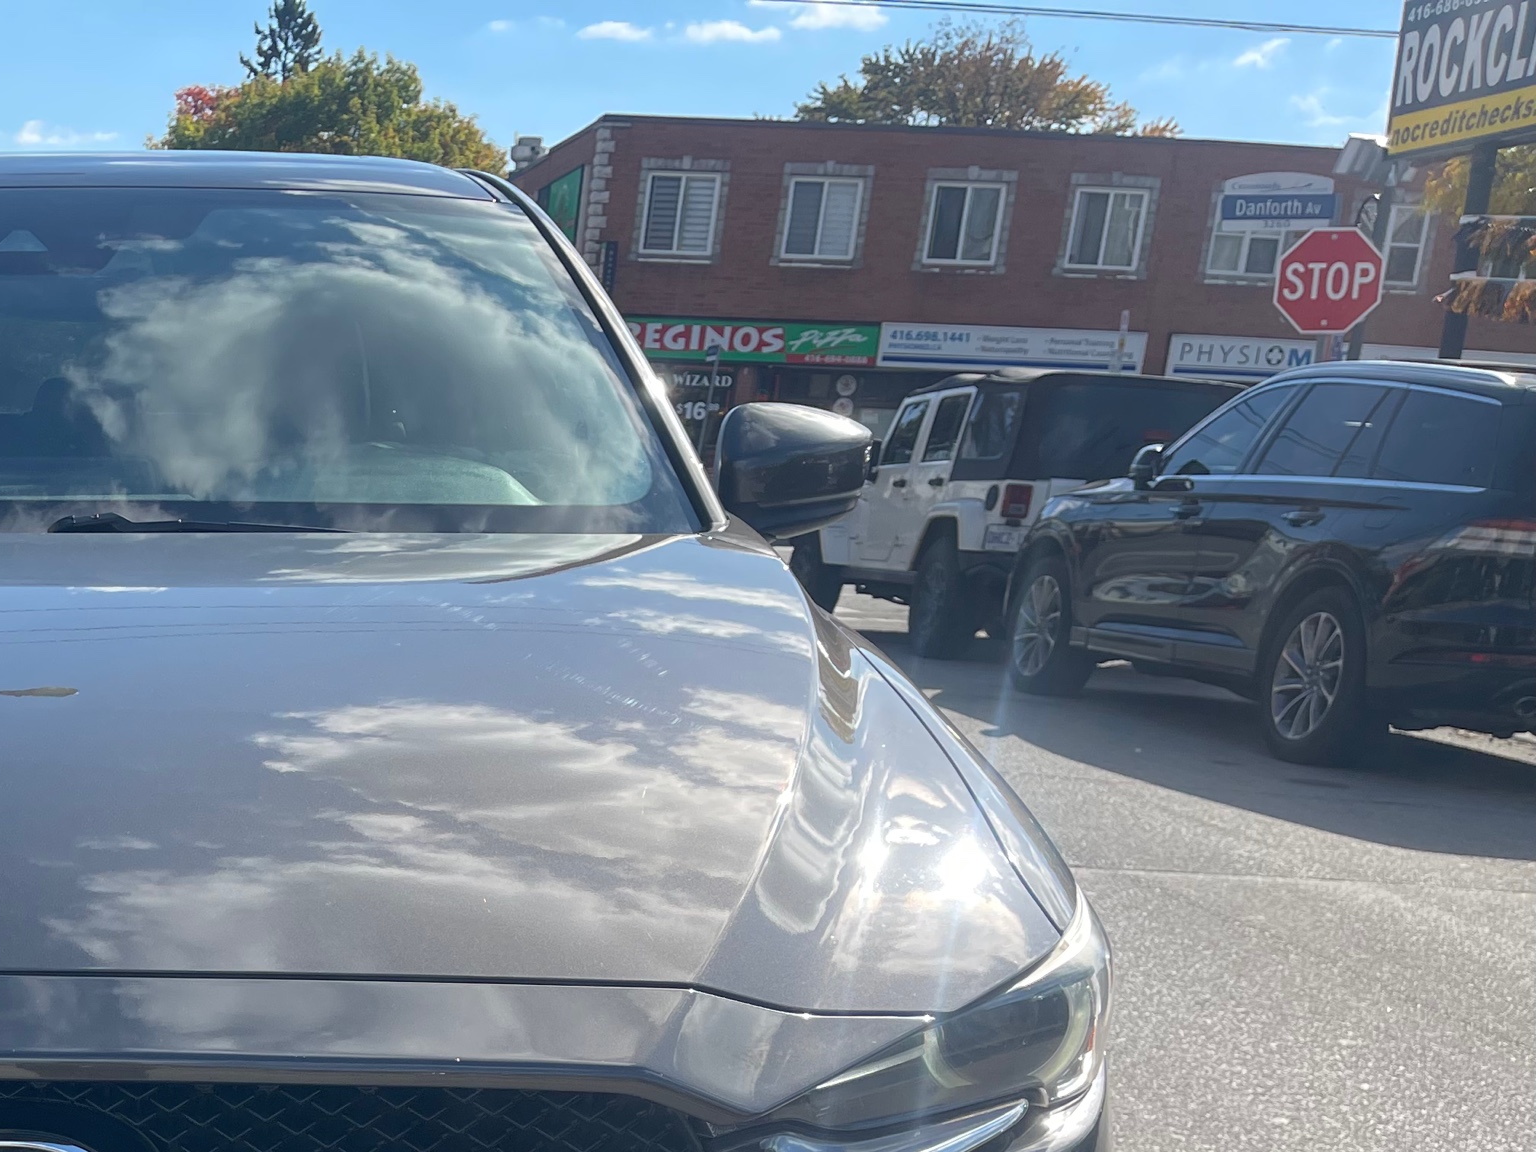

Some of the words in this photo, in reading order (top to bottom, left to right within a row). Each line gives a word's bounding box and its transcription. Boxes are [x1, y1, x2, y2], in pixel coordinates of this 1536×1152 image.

[1235, 199, 1302, 216] Danforth
[1305, 202, 1322, 215] Av
[1282, 261, 1376, 301] STOP
[627, 322, 785, 353] REGINOS
[672, 371, 733, 387] WIZARD
